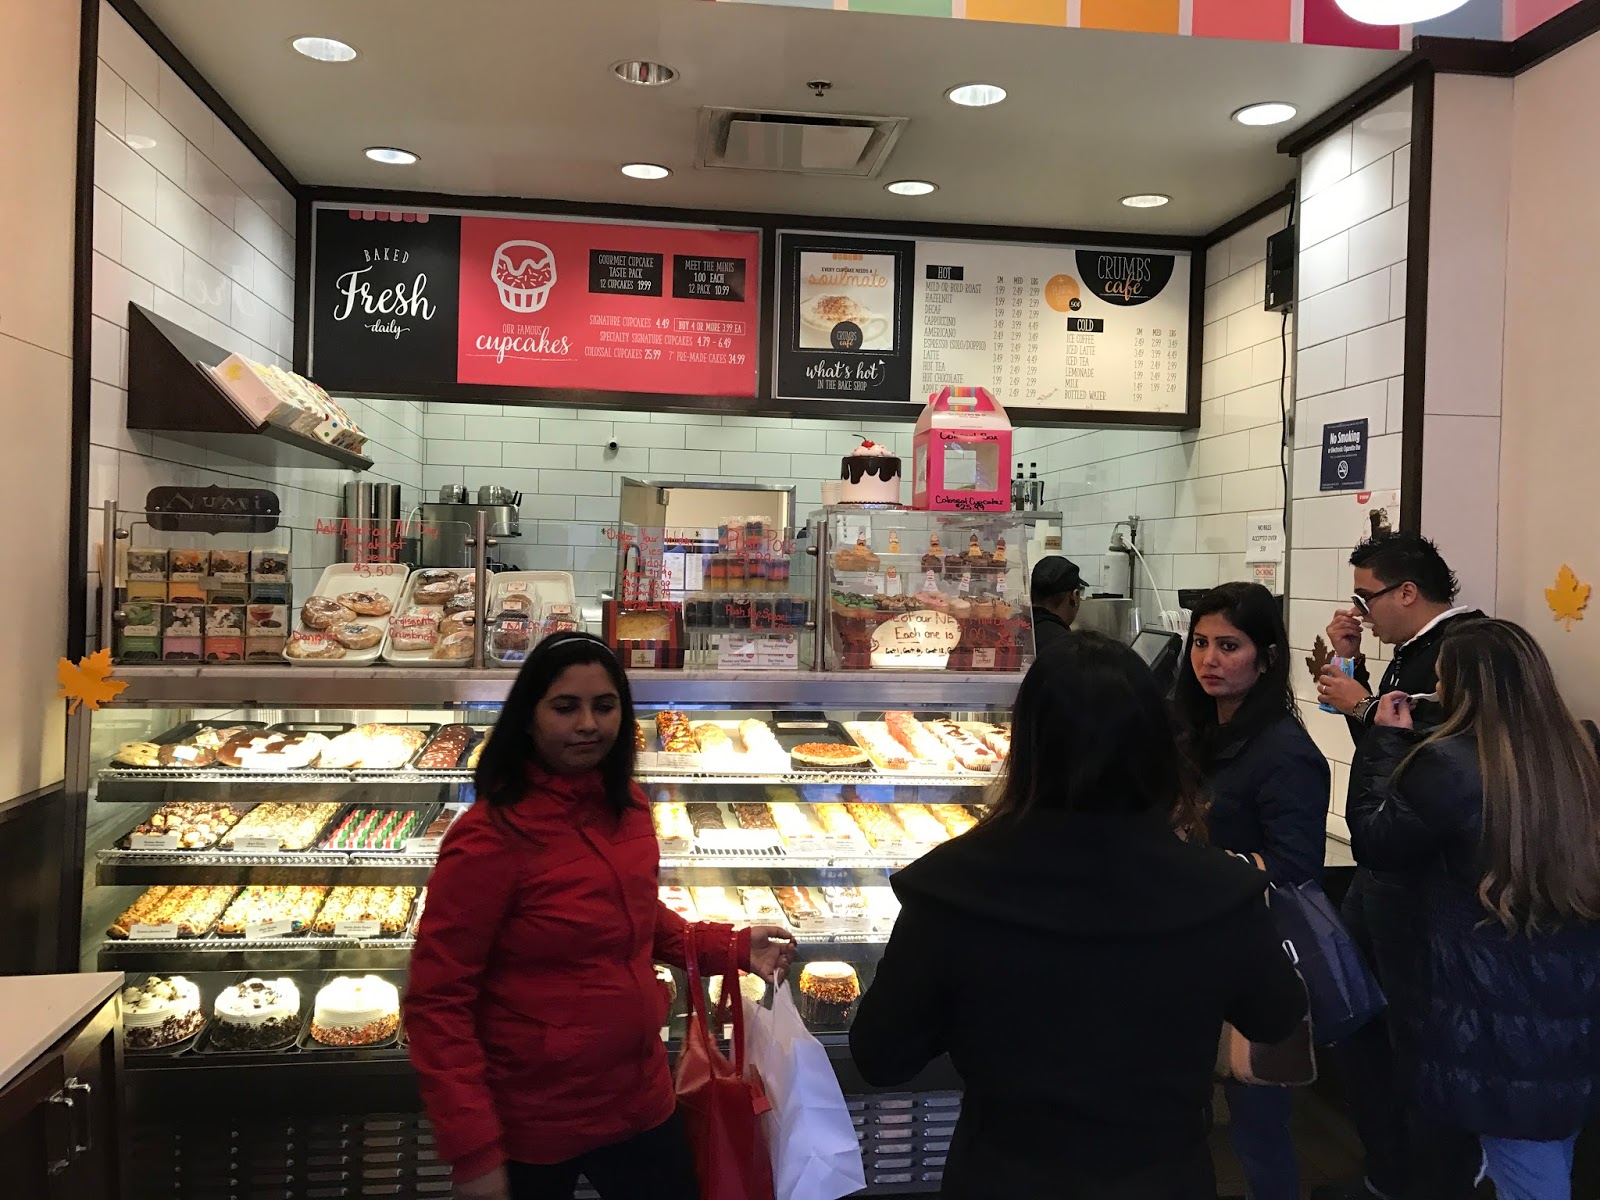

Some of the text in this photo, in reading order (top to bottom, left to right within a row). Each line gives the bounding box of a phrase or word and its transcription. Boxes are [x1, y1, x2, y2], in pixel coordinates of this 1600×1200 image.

[364, 248, 409, 264] BAKED
[599, 254, 654, 268] GOURMET CUPCAKE
[609, 266, 643, 279] TASTE PACK
[685, 260, 735, 273] MEET THE MINIS
[1097, 255, 1151, 281] CRUMBS
[710, 273, 725, 284] EACH
[807, 266, 888, 288] soulmate
[938, 266, 952, 280] HOT
[600, 279, 607, 289] 12
[608, 279, 634, 290] CUPCAKES
[688, 283, 695, 293] 12
[697, 284, 711, 295] PACK
[925, 282, 940, 292] MILD
[941, 283, 949, 292] OR
[950, 283, 964, 293] BOLD
[965, 284, 982, 293] ROAST
[334, 265, 436, 321] Fresh
[925, 293, 953, 304] HAZELNUT
[924, 304, 941, 315] DECAF
[589, 315, 621, 327] SIGNATURE
[622, 316, 652, 328] CUPCAKES
[678, 320, 689, 330] BUY
[696, 321, 704, 331] OR
[705, 322, 721, 332] MORE
[734, 324, 742, 333] EA
[924, 316, 957, 327] CAPPUCCINO
[1077, 319, 1094, 332] COLD
[364, 319, 411, 340] daily
[502, 323, 543, 336] OUR FAMOUS
[836, 330, 858, 341] CRUMBS
[924, 327, 957, 338] AMERICANO
[599, 331, 630, 343] SPECIALTY
[631, 333, 663, 345] SIGNATURE
[664, 334, 693, 346] CUPCAKES
[923, 339, 949, 349] ESPRESSO
[1066, 334, 1075, 344] ICE
[1076, 334, 1095, 345] COFFEE
[476, 327, 573, 364] cupcakes
[1066, 345, 1095, 355] ICED LATTE
[584, 346, 612, 357] COLOSSAL
[614, 348, 643, 360] CUPCAKES
[676, 351, 707, 363] PRE-MADE
[708, 353, 727, 364] CAKES
[923, 350, 940, 360] LATTE
[922, 361, 946, 372] HOT TEA
[1066, 356, 1078, 366] ICED
[1079, 356, 1090, 367] TEA
[806, 359, 879, 380] what's hot
[1065, 367, 1095, 378] LEMONADE
[922, 372, 964, 384] HOT CHOCOLATE
[1065, 379, 1079, 389] MILK
[817, 379, 868, 391] IN THE BAKE SHOP
[1064, 389, 1107, 401] BOTTLED WATER
[1329, 430, 1361, 445] No Smoking
[895, 627, 921, 640] Each
[924, 630, 941, 640] one
[945, 629, 955, 640] is
